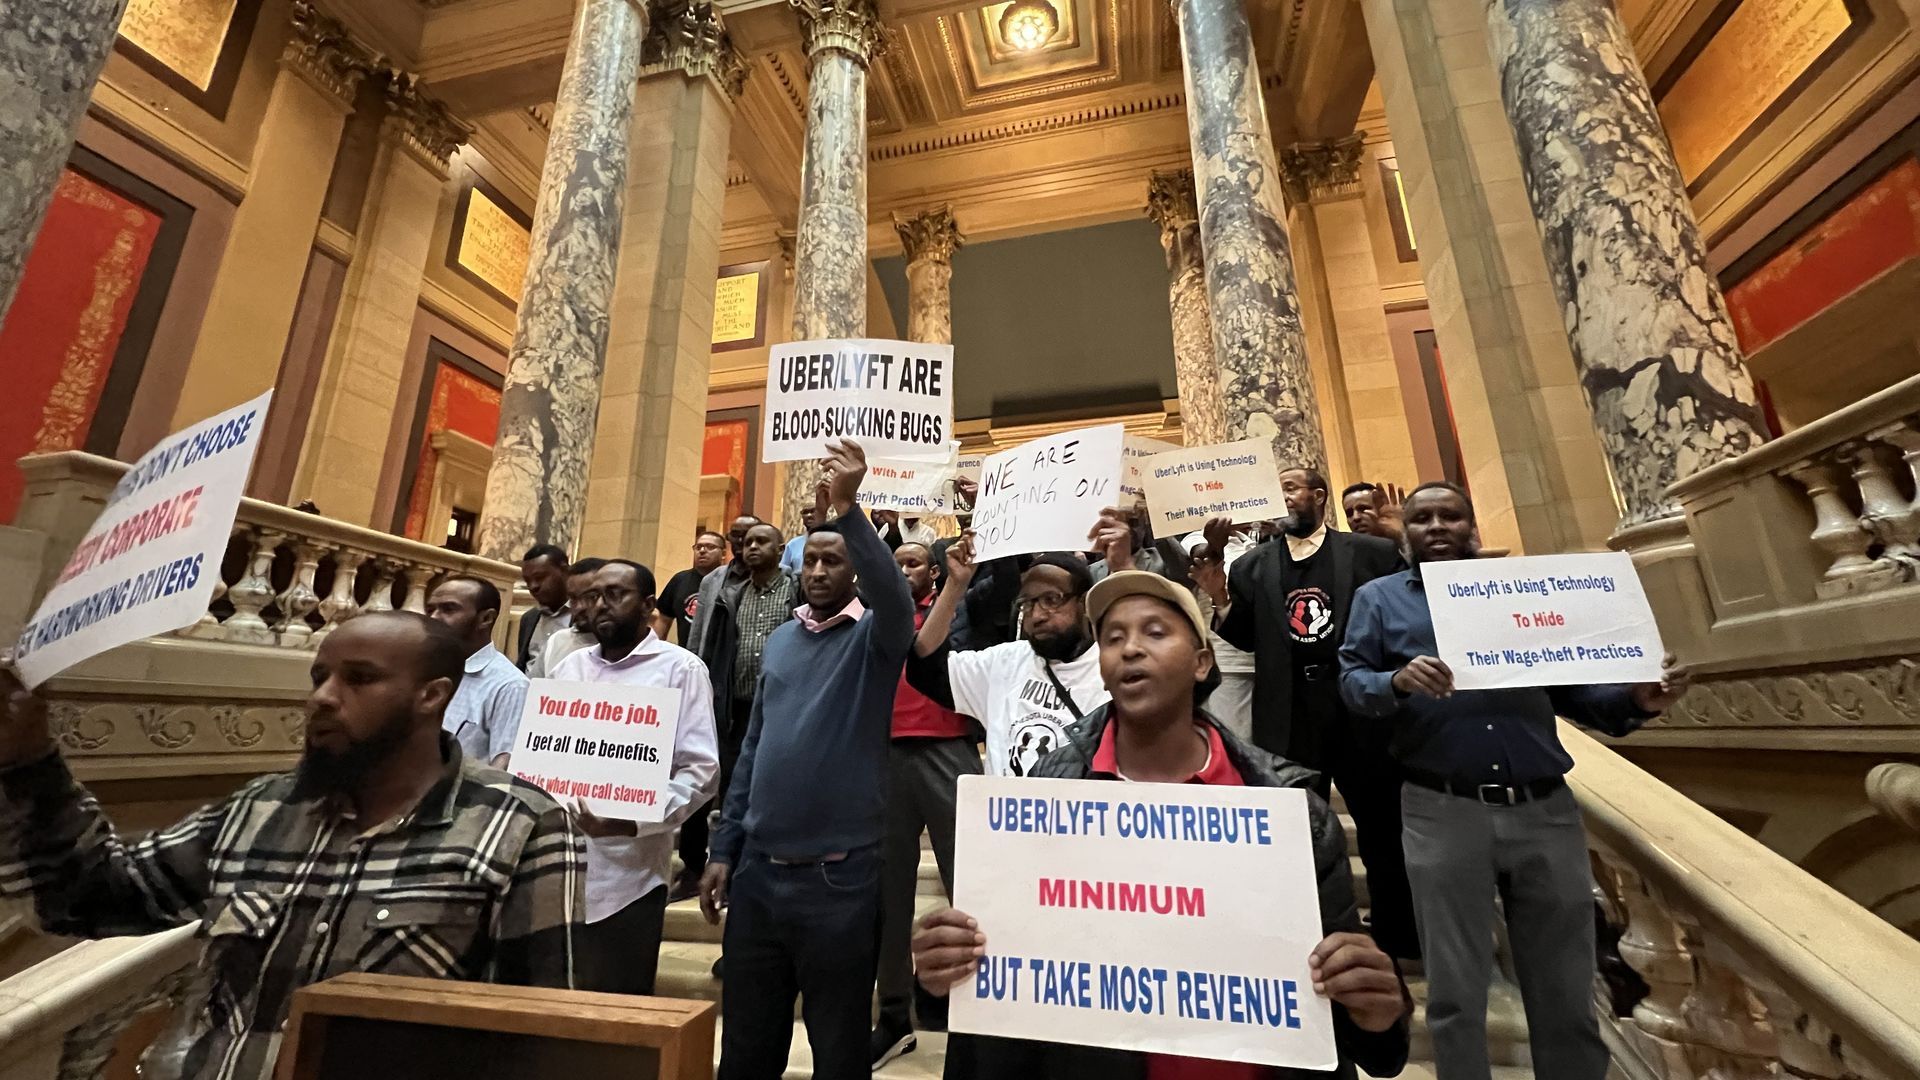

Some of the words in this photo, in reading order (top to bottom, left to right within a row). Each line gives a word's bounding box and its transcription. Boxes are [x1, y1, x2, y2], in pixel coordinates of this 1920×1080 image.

[779, 351, 893, 394] UBER/LYFT
[898, 357, 942, 397] ARE
[183, 411, 256, 468] CHOOSE
[772, 406, 896, 442] BLOOD-SUCKING
[899, 411, 942, 445] BUGS
[872, 466, 897, 479] With
[899, 470, 915, 480] All
[984, 457, 1018, 497] WE
[1033, 440, 1080, 471] ARE
[1154, 462, 1187, 479] Uber/Lyft
[1187, 461, 1194, 472] is
[1195, 458, 1216, 473] Using
[1217, 454, 1257, 469] Technology
[974, 477, 1058, 529] COUNTING
[1075, 478, 1108, 498] ON
[1193, 482, 1204, 493] To
[1205, 480, 1224, 491] Hide
[100, 485, 204, 564] CORPORATE
[1165, 509, 1185, 522] Their
[1186, 503, 1229, 517] Wage-theft
[1230, 497, 1269, 511] Practices
[978, 514, 1017, 553] YOU
[127, 552, 204, 610] DRIVERS
[1447, 581, 1499, 600] Uber/Lyft
[1500, 579, 1512, 595] is
[1514, 578, 1548, 596] Using
[1547, 574, 1616, 593] Technology
[1512, 613, 1530, 629] To
[1532, 610, 1565, 627] Hide
[1466, 650, 1500, 667] Their
[1502, 646, 1576, 667] Wage-theft
[1576, 643, 1644, 661] Practices
[538, 695, 567, 717] You
[569, 698, 591, 719] do
[594, 700, 624, 722] the
[625, 703, 661, 728] job,
[526, 731, 533, 749] I
[533, 735, 552, 752] get
[554, 735, 571, 753] all
[574, 737, 596, 756] the
[597, 739, 660, 765] benefits,
[536, 774, 546, 788] is
[545, 776, 569, 795] what
[570, 780, 591, 798] you
[591, 782, 612, 800] call
[613, 784, 657, 806] slavery.
[988, 796, 1109, 836] UBER/LYFT
[1116, 801, 1272, 845] CONTRIBUTE
[1039, 877, 1206, 917] MINIMUM
[975, 954, 1022, 1001] BUT
[1029, 958, 1092, 1008] TAKE
[1099, 963, 1168, 1016] MOST
[1176, 970, 1301, 1030] REVENUE
